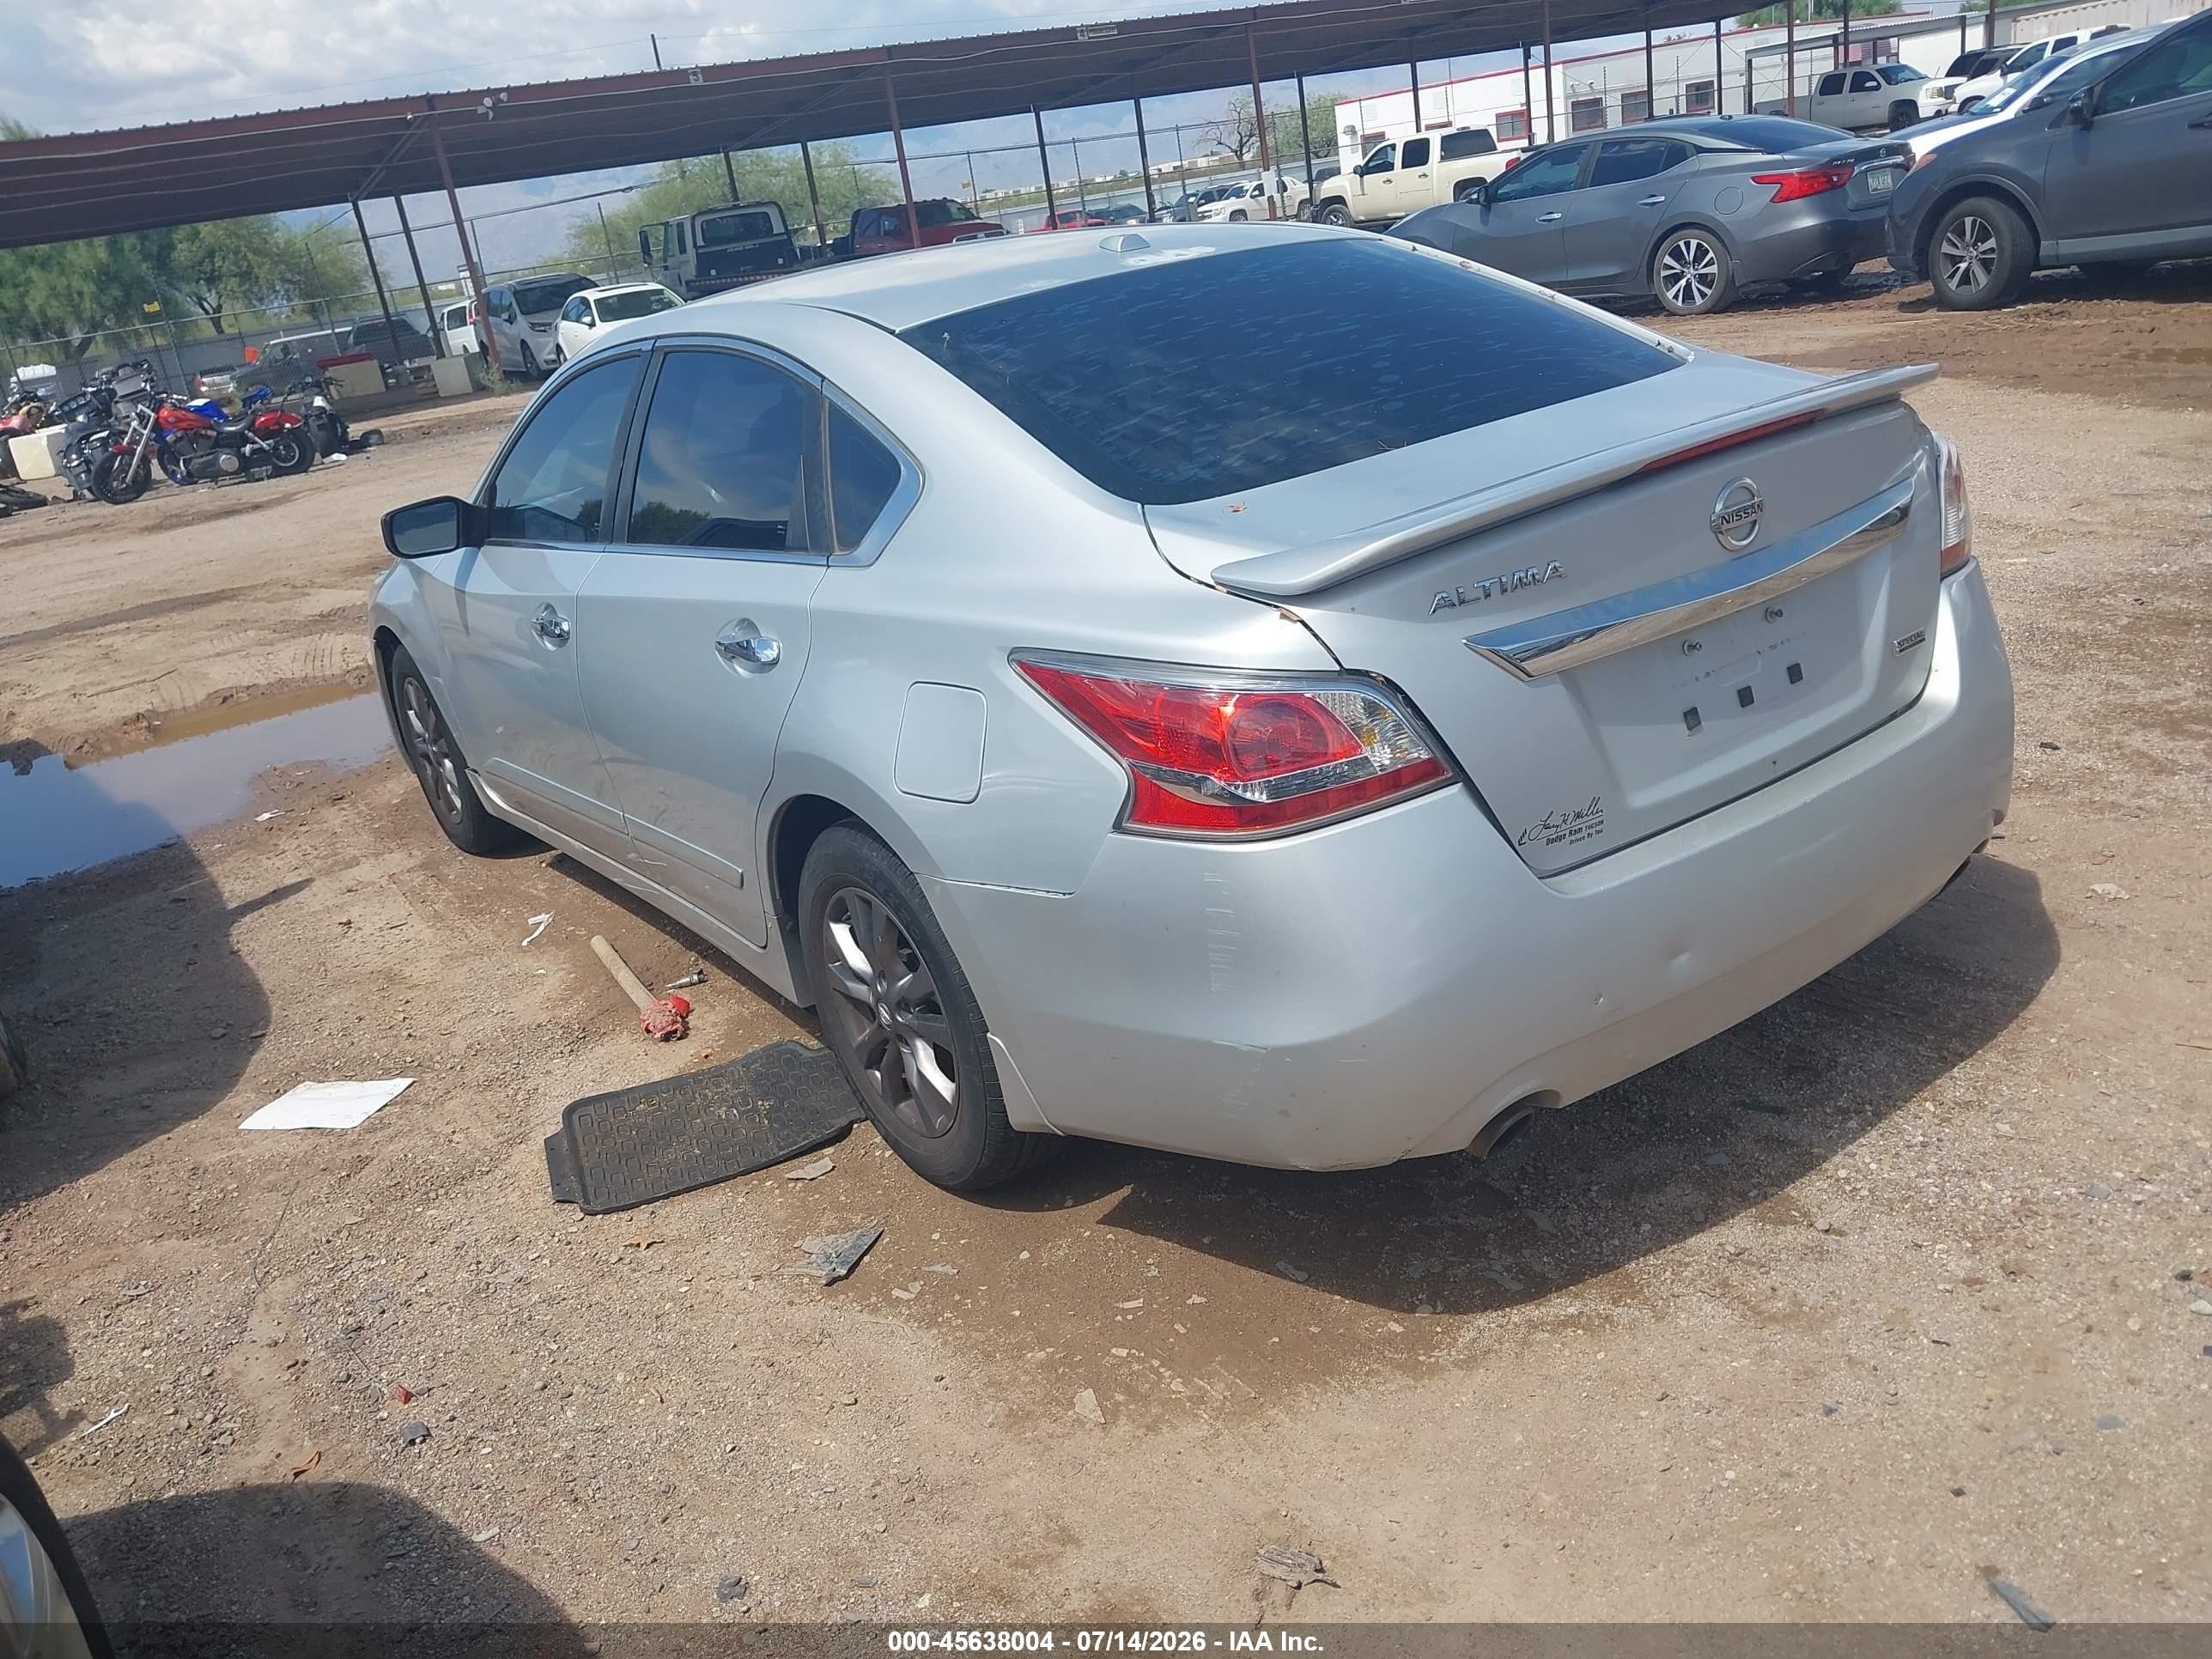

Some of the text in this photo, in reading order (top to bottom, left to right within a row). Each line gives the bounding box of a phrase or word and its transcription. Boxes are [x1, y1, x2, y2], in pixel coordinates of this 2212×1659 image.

[1720, 502, 1764, 526] NISSAN
[1428, 560, 1569, 616] ALTIMA
[1896, 631, 1925, 648] SPECIAL
[1570, 796, 1605, 825] Miller
[1546, 818, 1605, 847] Dodge Ram TUCSON
[1569, 835, 1586, 846] Driven
